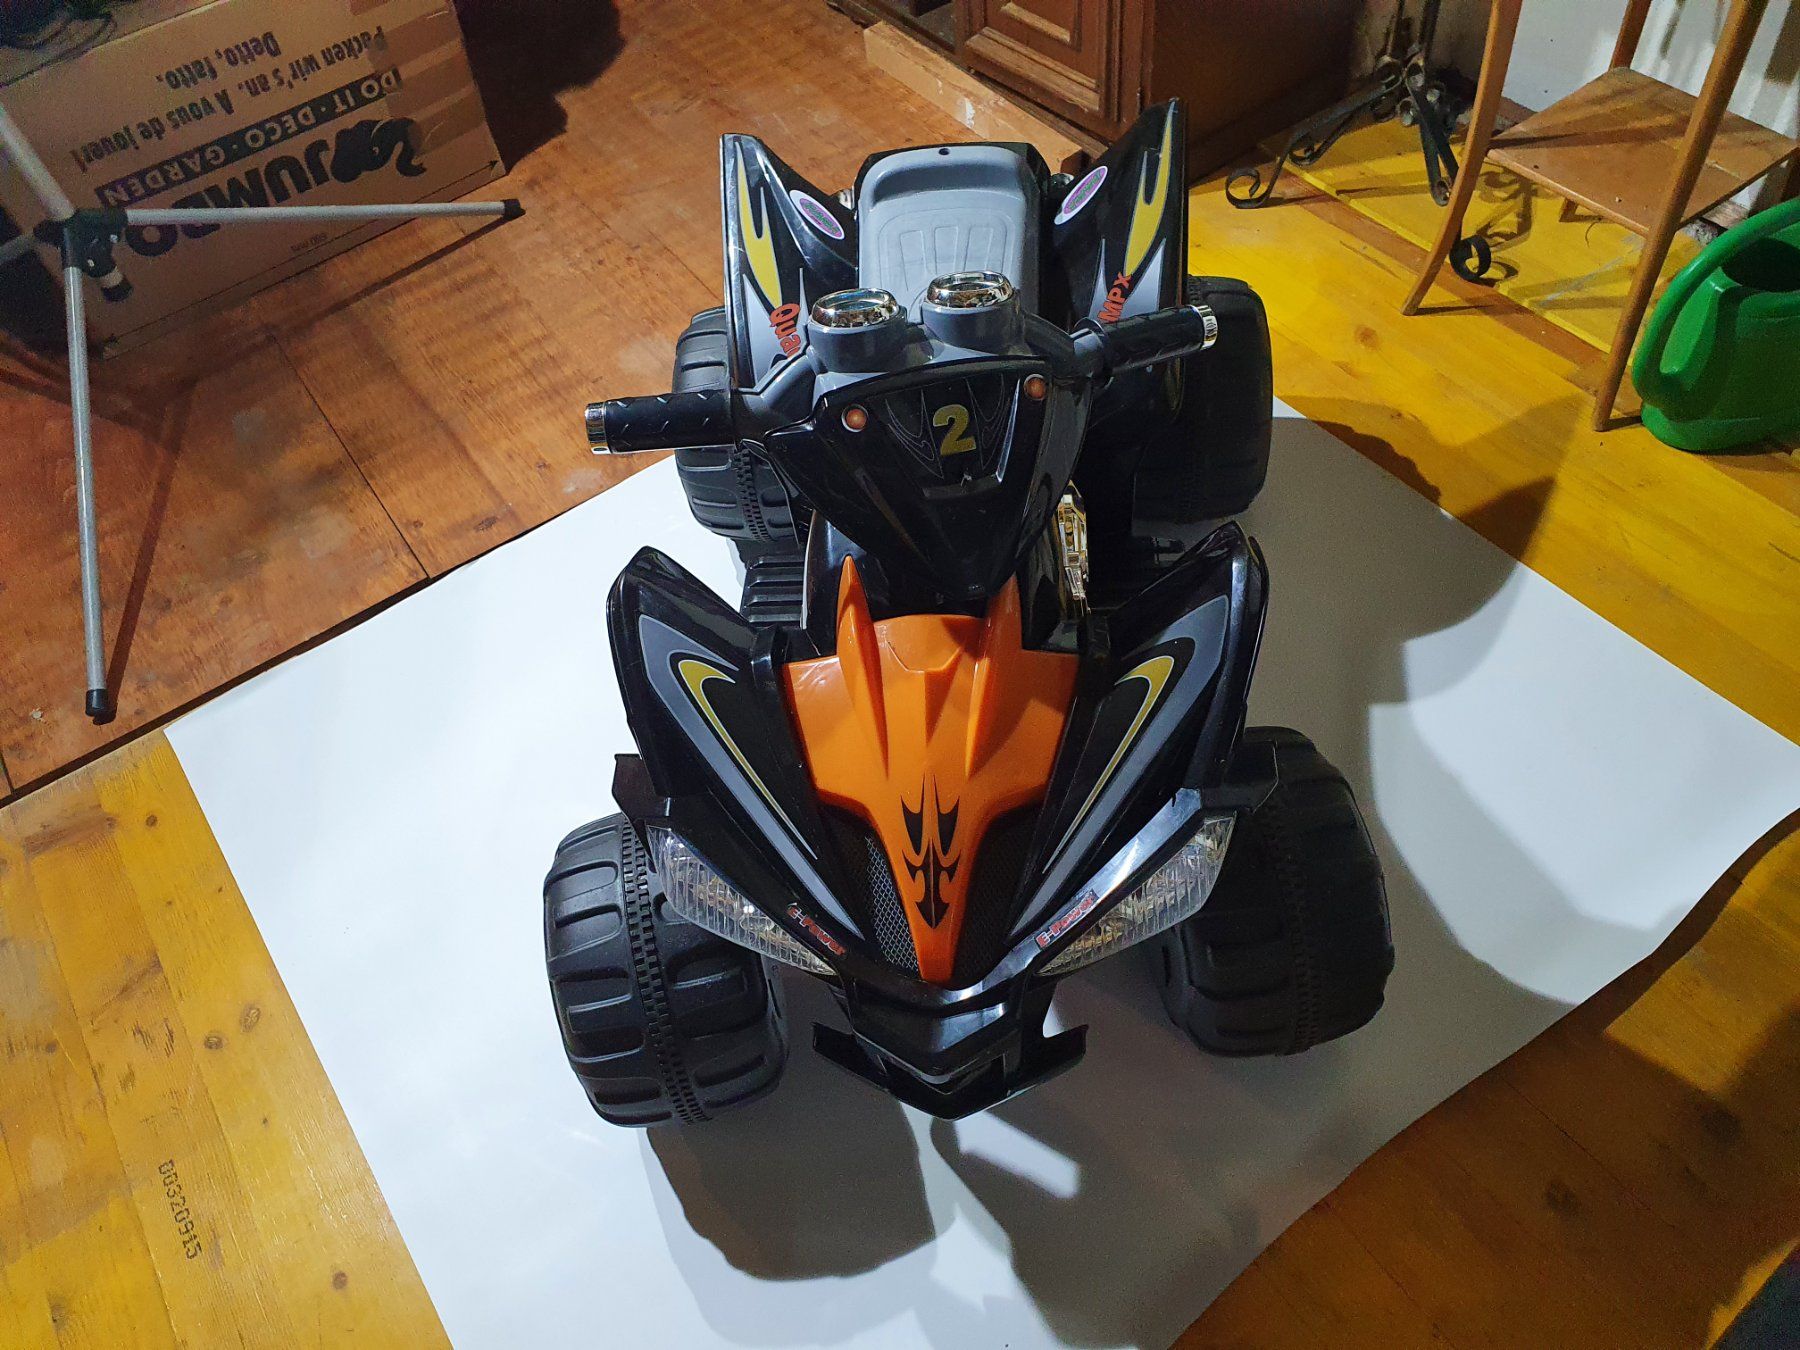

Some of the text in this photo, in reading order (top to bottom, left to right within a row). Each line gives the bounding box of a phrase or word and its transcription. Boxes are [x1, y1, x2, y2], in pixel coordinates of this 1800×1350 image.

[155, 31, 282, 90] Detto, fatto.
[321, 26, 386, 66] Packen
[214, 89, 235, 116] A
[237, 67, 272, 98] an.
[360, 68, 402, 98] DO
[136, 117, 166, 141] de
[165, 96, 216, 130] vous
[244, 105, 317, 148] DECO
[70, 124, 139, 173] jouer!
[102, 144, 226, 208] GARDEN
[932, 403, 977, 456] 2
[158, 1159, 202, 1260] 00320915
